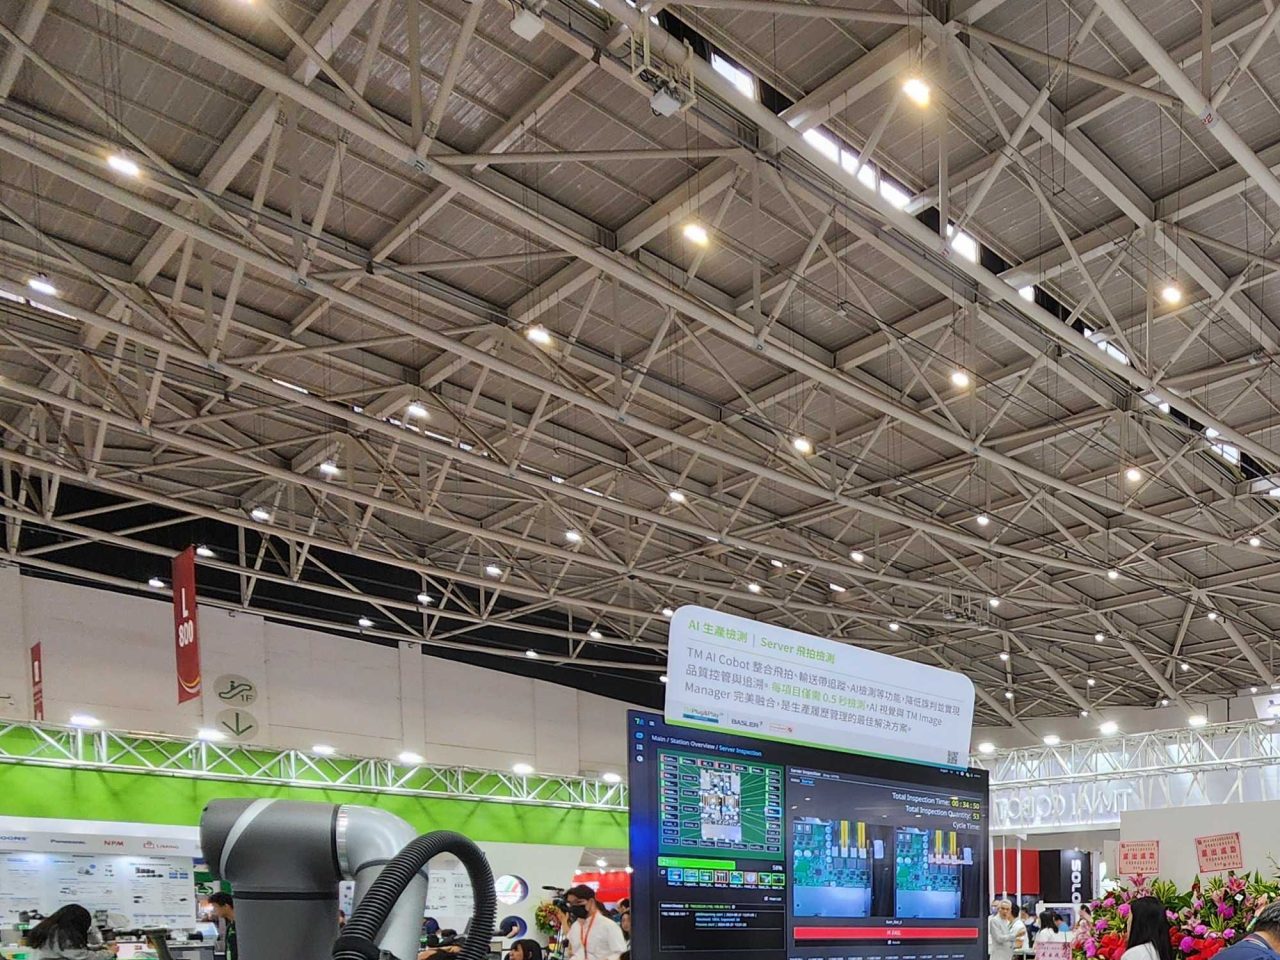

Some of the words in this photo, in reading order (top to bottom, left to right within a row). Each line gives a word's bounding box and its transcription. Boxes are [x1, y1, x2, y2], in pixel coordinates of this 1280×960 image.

[181, 587, 189, 618] L
[178, 620, 194, 648] 800
[688, 619, 700, 631] AI
[760, 637, 794, 654] Server
[687, 647, 703, 659] TM
[705, 651, 716, 662] AI
[719, 654, 750, 670] Cobot
[240, 693, 253, 703] 1F
[685, 681, 732, 701] Manager
[823, 692, 837, 704] 0.5
[906, 710, 918, 721] TM
[919, 711, 943, 727] Image
[651, 735, 666, 743] Main
[670, 738, 690, 746] Station
[690, 740, 715, 750] Overview
[719, 745, 736, 753] Server
[891, 792, 906, 800] Total
[907, 795, 935, 804] Inspection
[905, 805, 919, 813] Total
[920, 806, 948, 816] Inspection
[952, 821, 967, 830] Cycle
